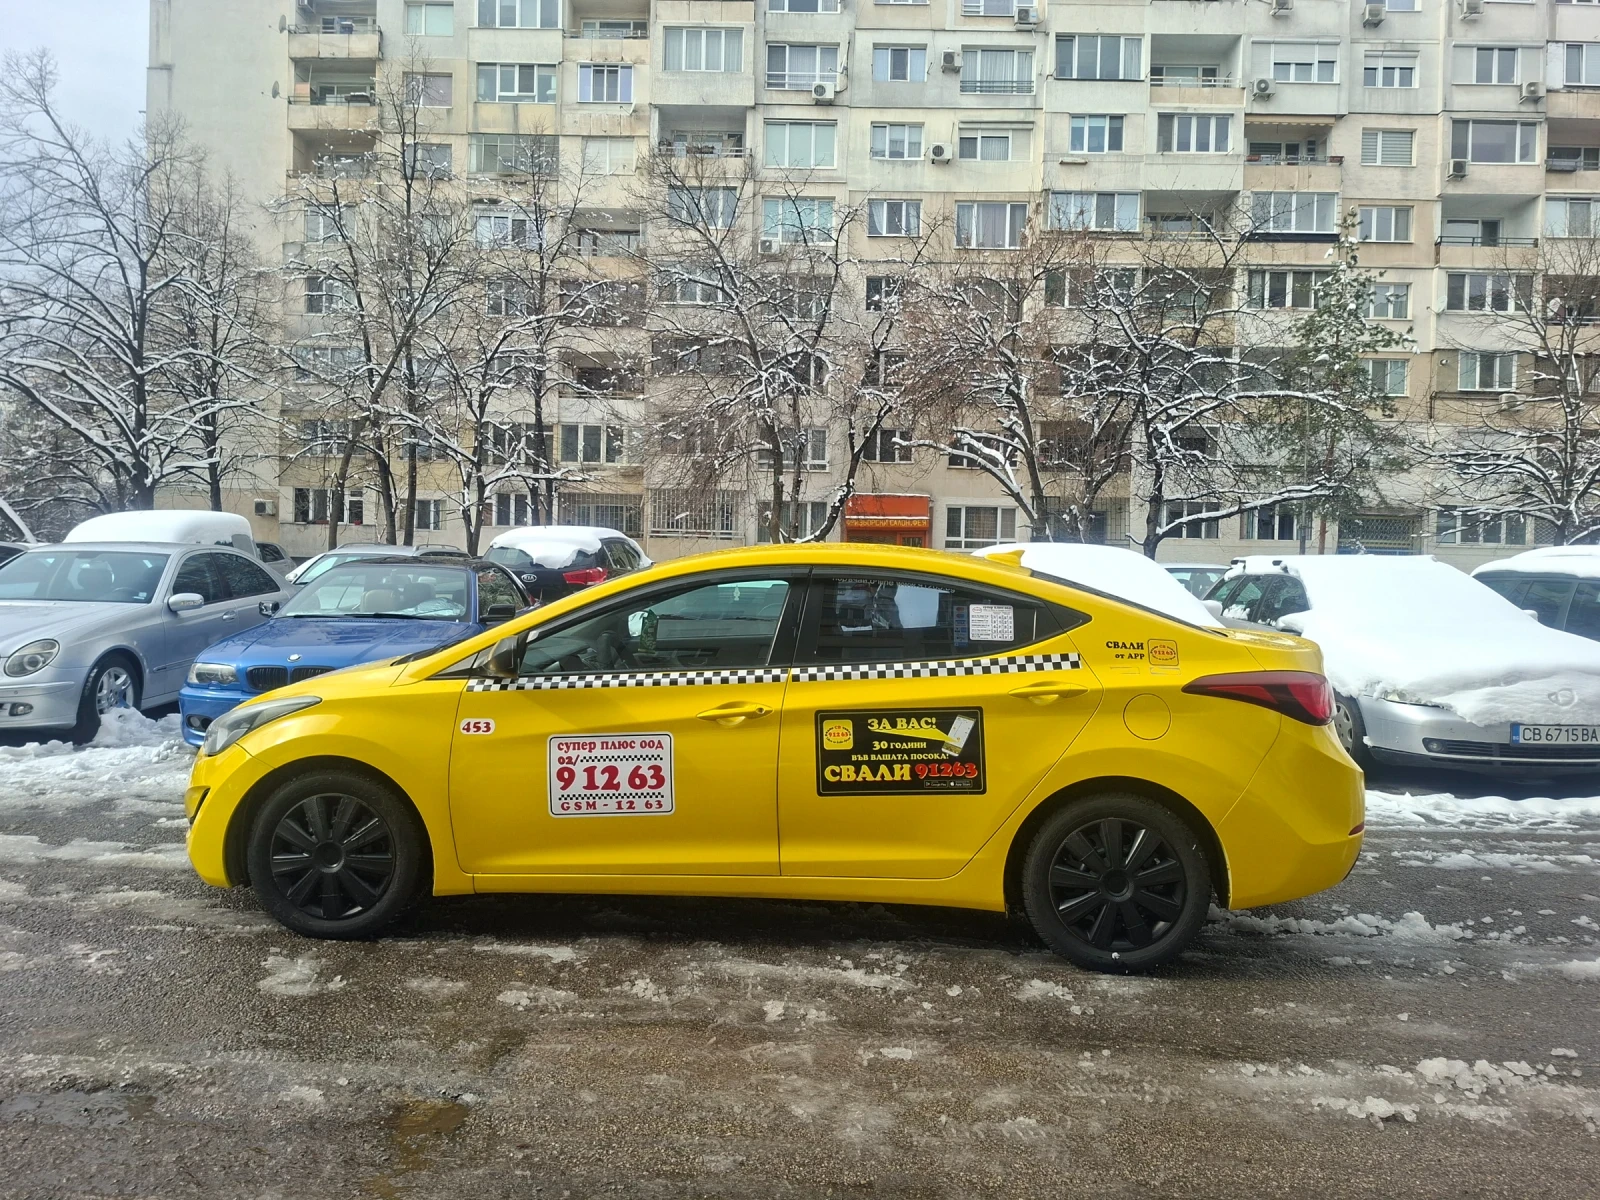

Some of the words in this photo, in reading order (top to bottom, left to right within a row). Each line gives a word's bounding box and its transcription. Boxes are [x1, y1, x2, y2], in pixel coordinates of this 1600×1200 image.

[1105, 641, 1144, 650] СВАЛИ
[462, 721, 492, 733] 453
[867, 718, 892, 730] ЗА
[896, 717, 937, 730] ВАС!
[557, 741, 597, 754] супер
[872, 740, 888, 751] 30
[870, 753, 908, 761] ВАШАТА
[824, 764, 912, 782] СВАЛИ
[914, 761, 978, 779] 91263
